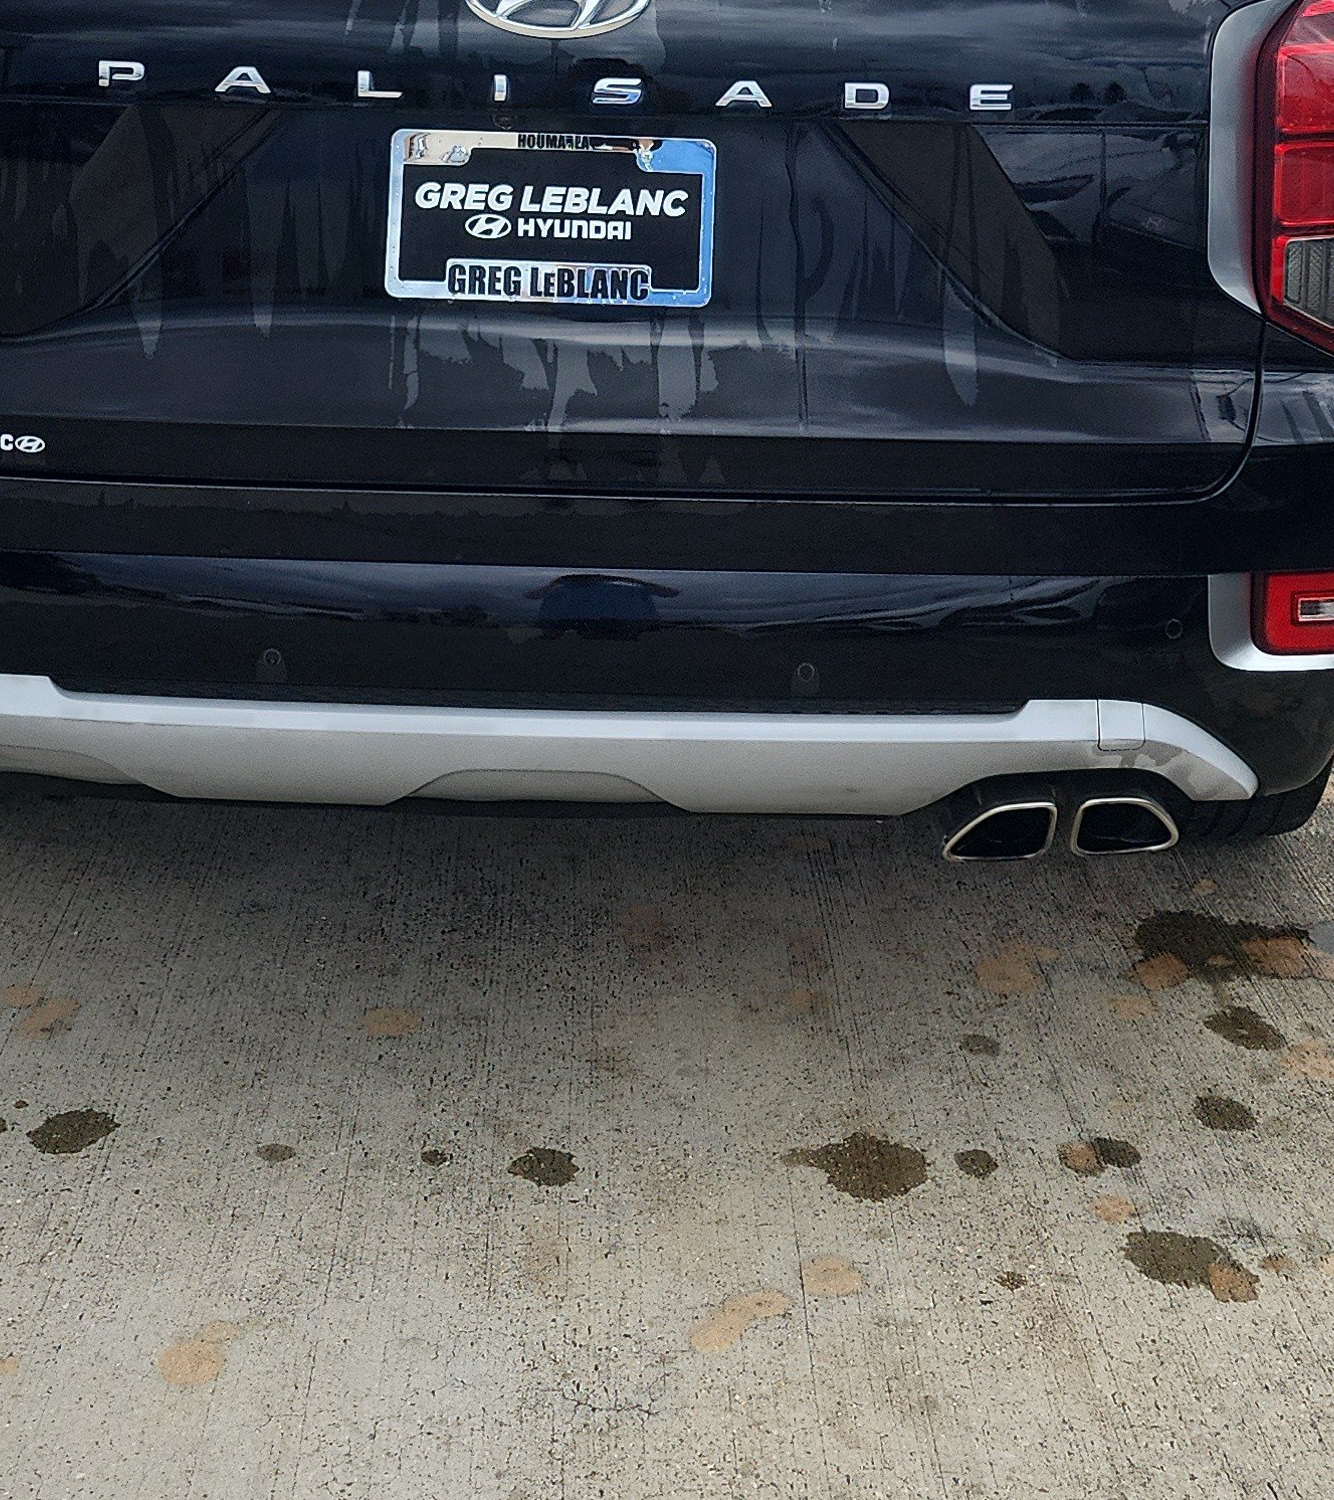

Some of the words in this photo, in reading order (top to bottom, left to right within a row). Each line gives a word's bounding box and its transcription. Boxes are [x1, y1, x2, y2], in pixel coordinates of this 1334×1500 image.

[98, 60, 1014, 111] PALISADE
[416, 182, 514, 211] GREG
[519, 186, 689, 217] LEBLANC
[517, 218, 632, 240] HYUNDAI
[447, 264, 522, 298] GREG
